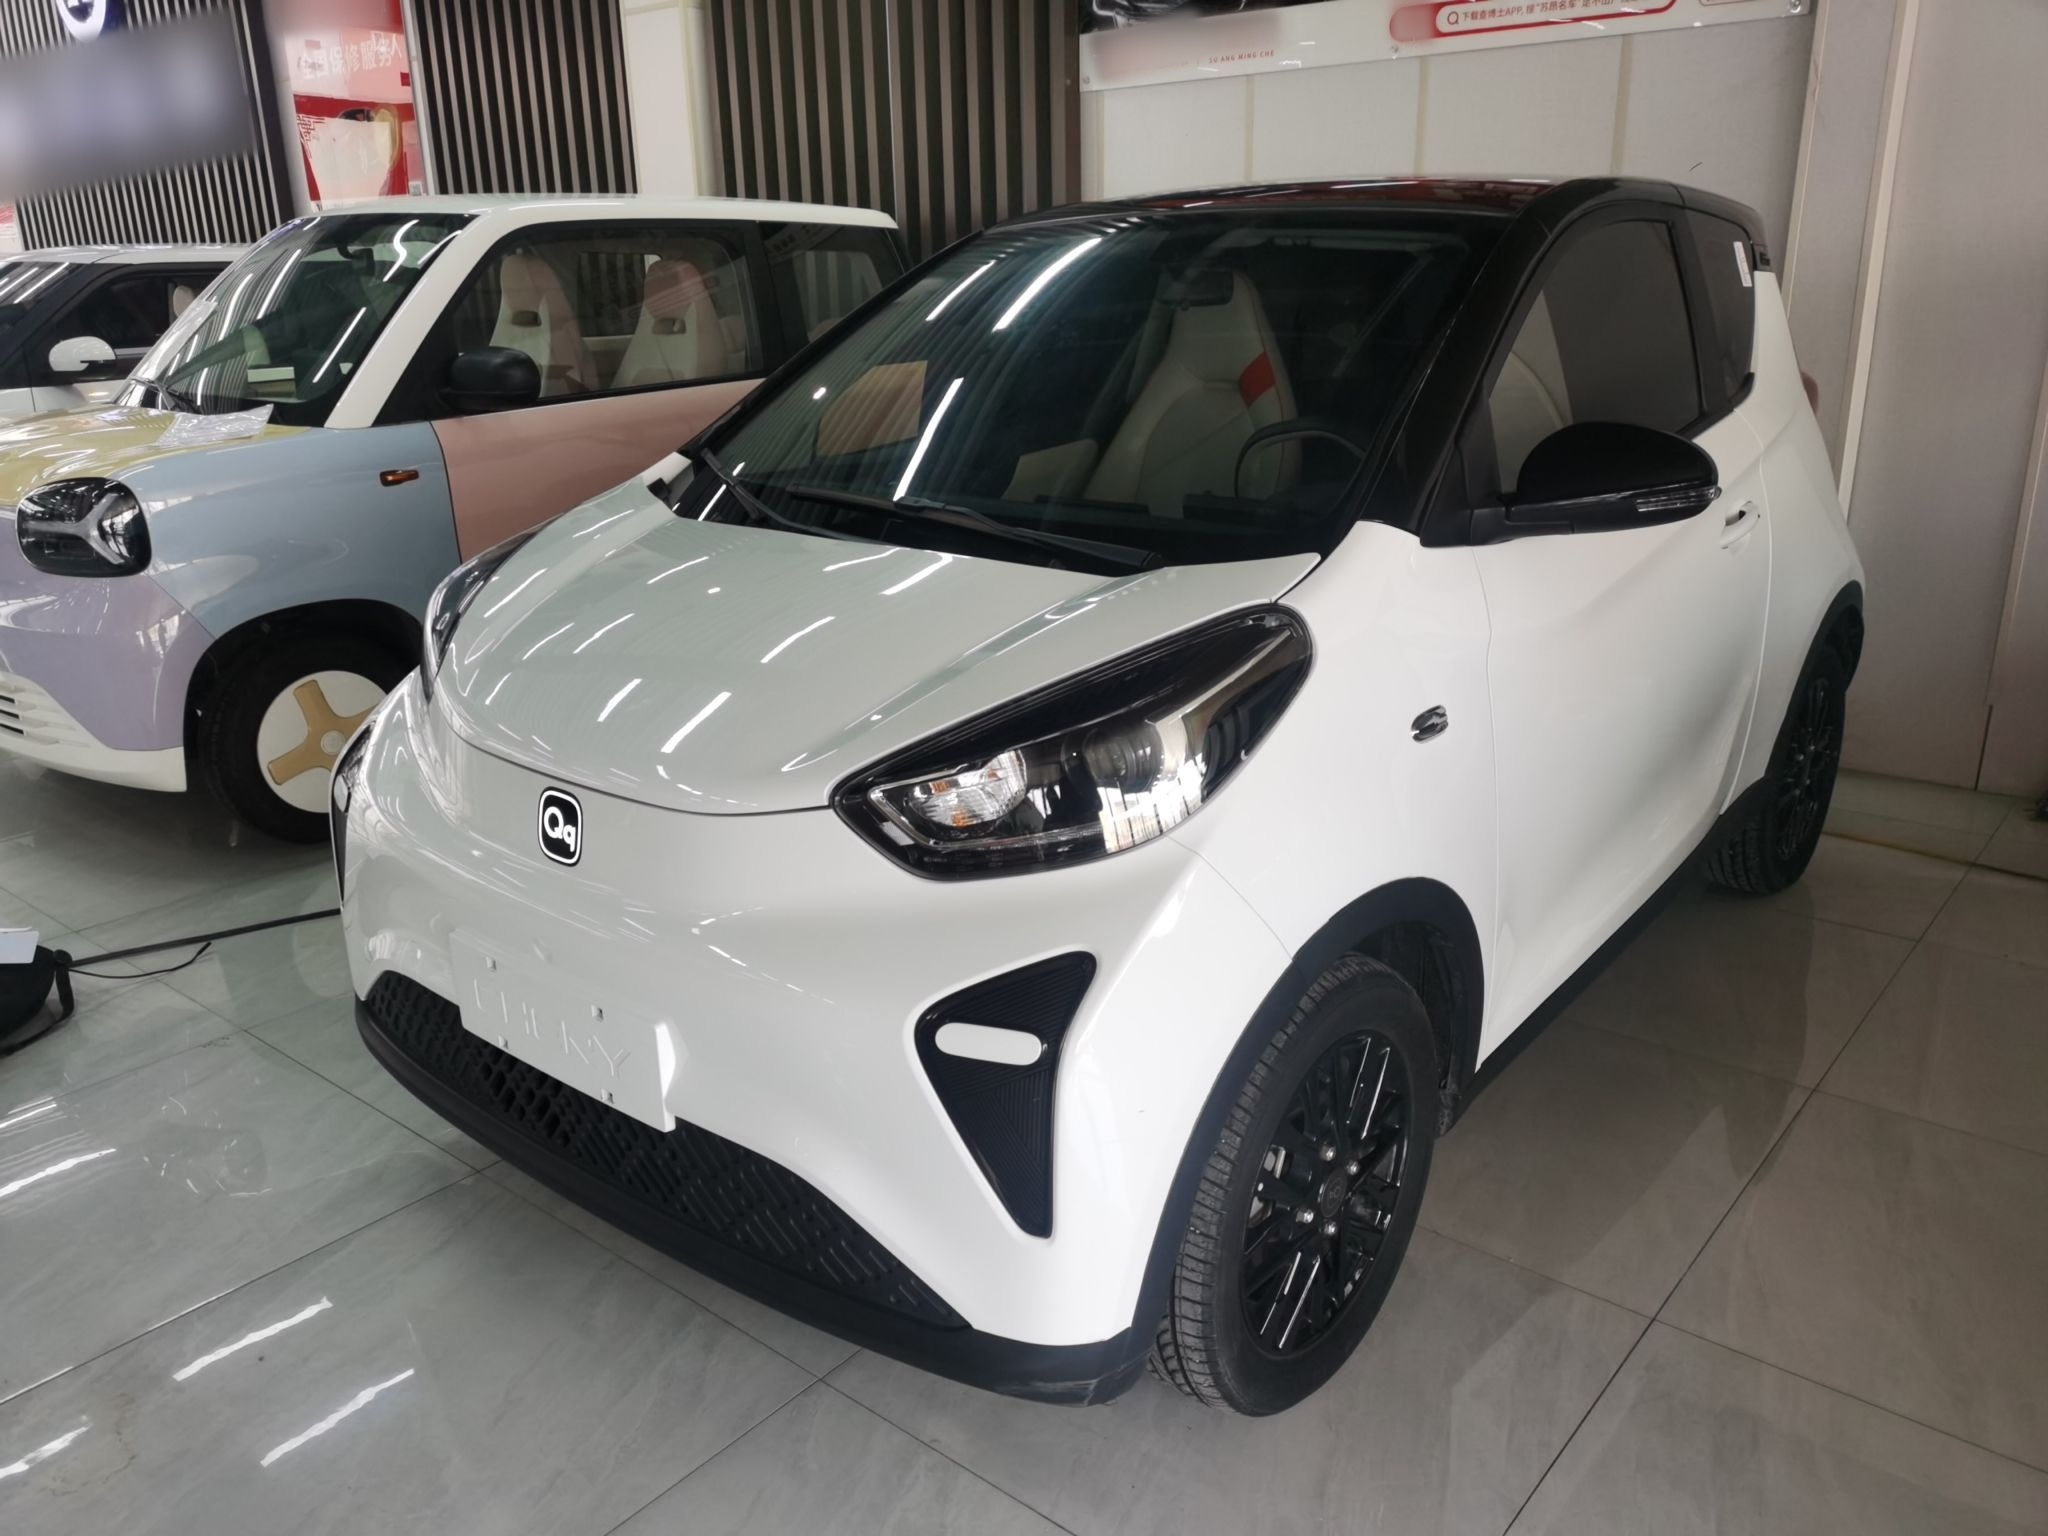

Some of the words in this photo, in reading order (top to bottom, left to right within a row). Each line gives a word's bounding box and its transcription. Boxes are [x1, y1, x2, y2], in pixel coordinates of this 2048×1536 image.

[1220, 54, 1236, 63] ANG
[1238, 52, 1257, 61] MING
[1259, 50, 1275, 58] CHE
